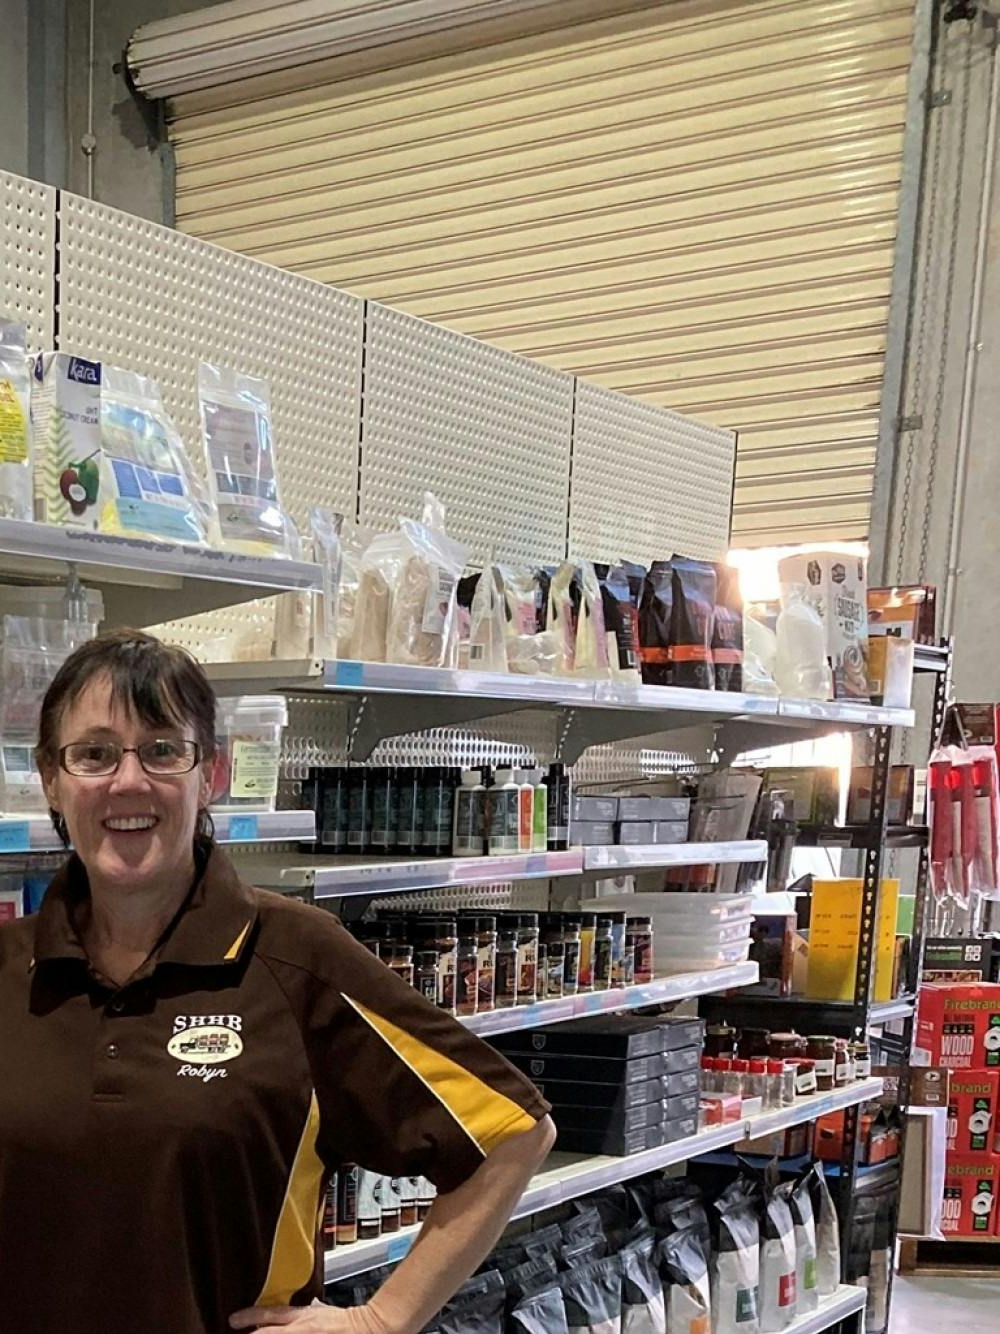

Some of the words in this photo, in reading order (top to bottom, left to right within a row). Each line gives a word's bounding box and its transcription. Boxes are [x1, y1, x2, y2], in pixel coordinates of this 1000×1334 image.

[944, 998, 1000, 1010] Firebran
[173, 1014, 242, 1034] SHHB
[941, 1035, 974, 1056] WOOD
[177, 1064, 228, 1082] Robyn
[951, 1083, 991, 1093] brand
[948, 1165, 993, 1175] ebrand
